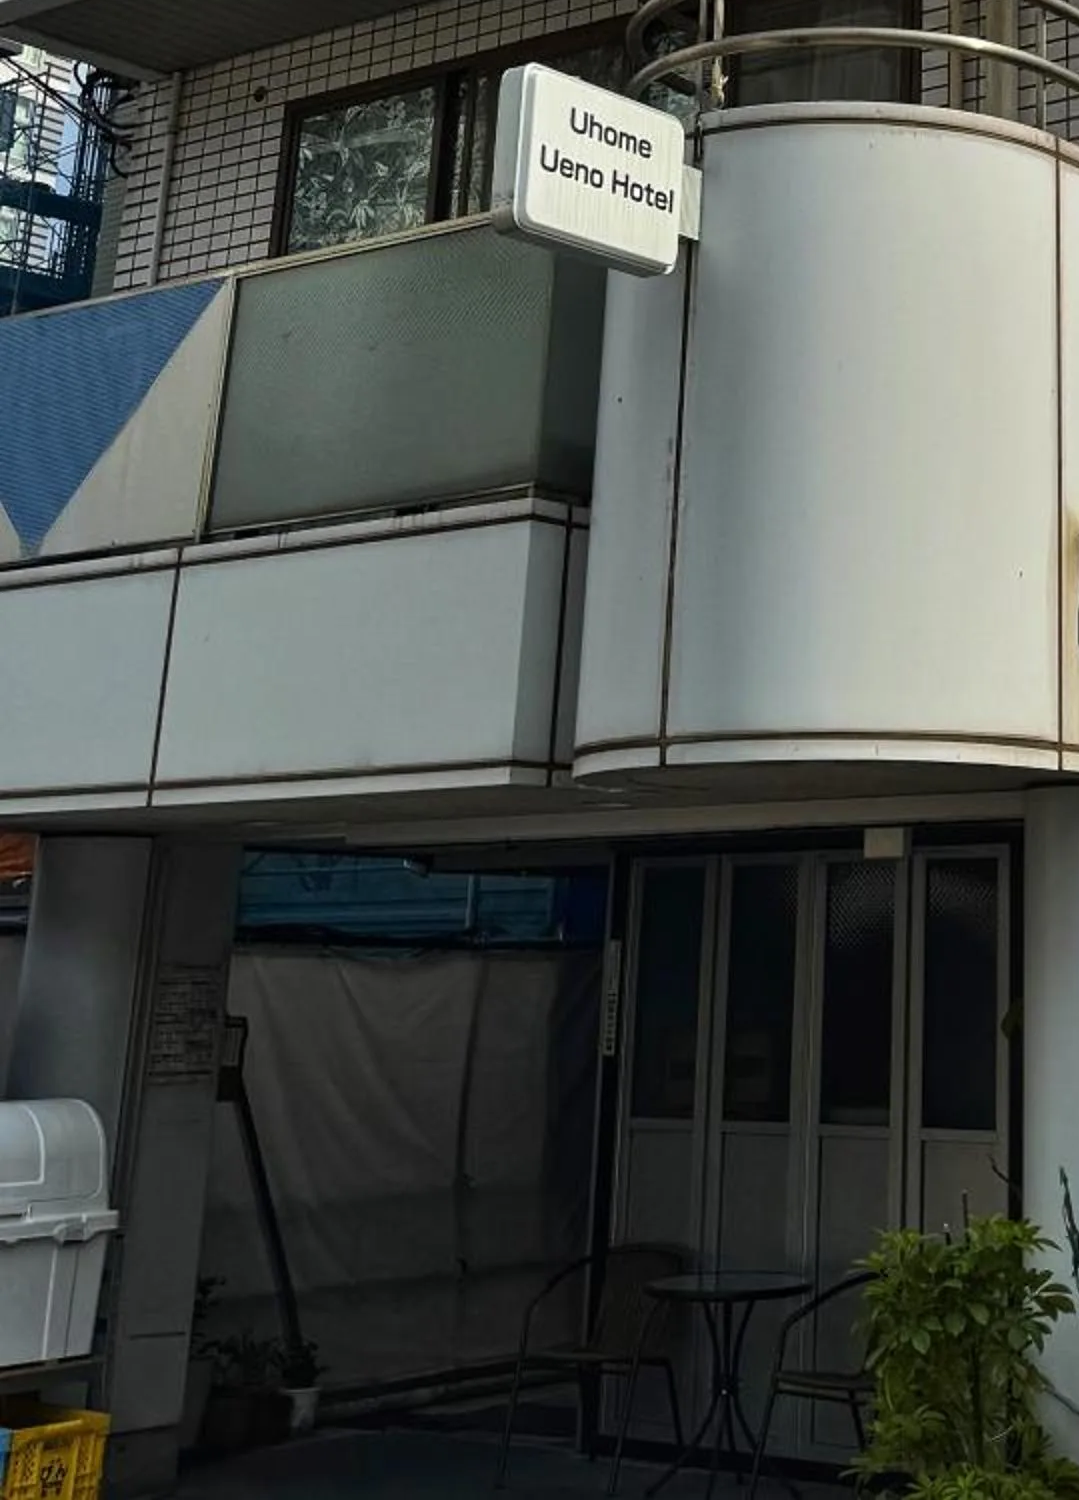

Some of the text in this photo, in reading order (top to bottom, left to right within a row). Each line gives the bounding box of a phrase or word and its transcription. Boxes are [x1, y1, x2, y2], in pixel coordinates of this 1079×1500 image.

[570, 107, 652, 159] Uhome
[540, 144, 674, 213] Ueno Hotel
